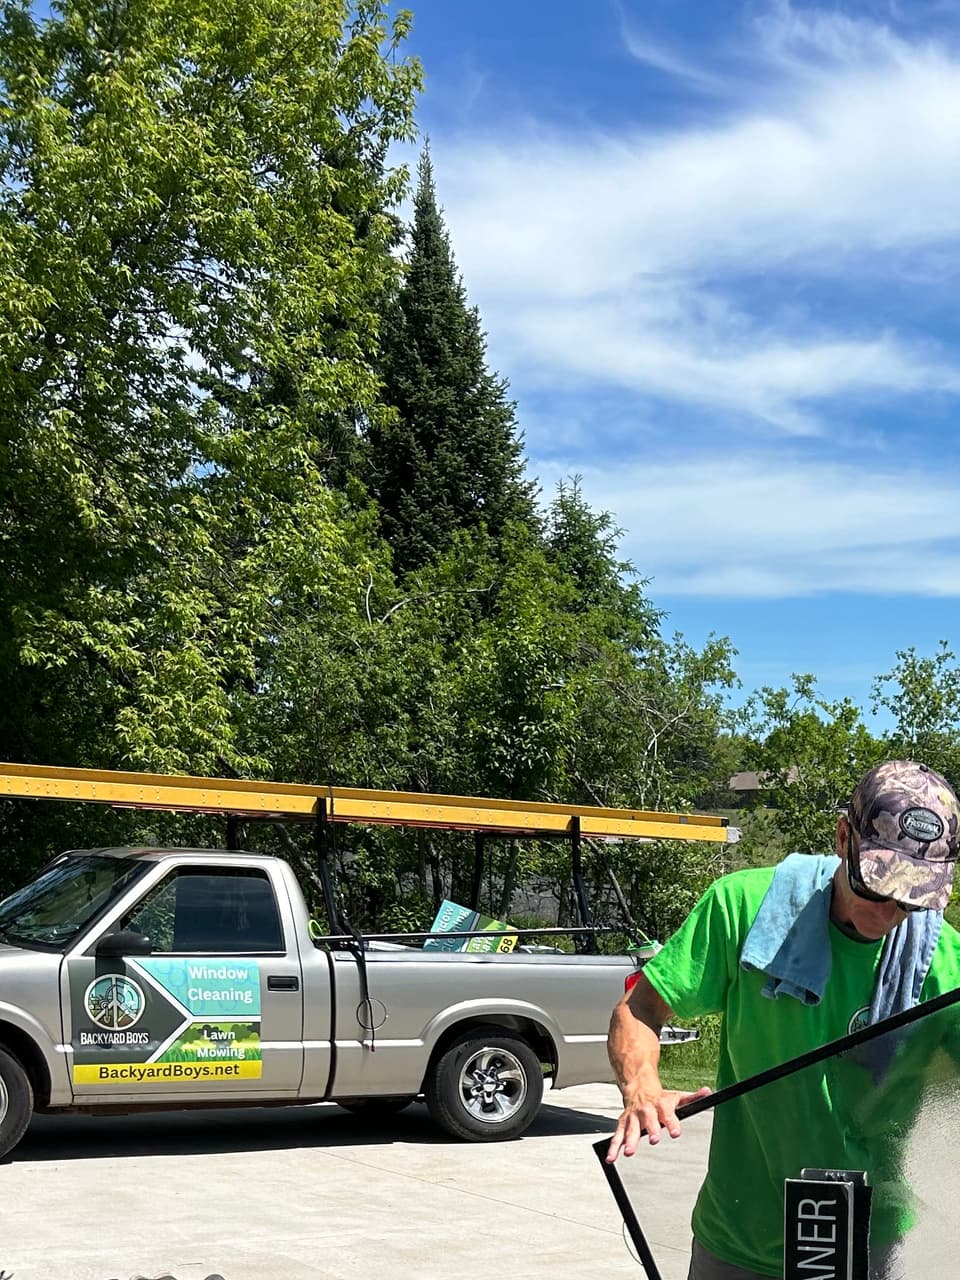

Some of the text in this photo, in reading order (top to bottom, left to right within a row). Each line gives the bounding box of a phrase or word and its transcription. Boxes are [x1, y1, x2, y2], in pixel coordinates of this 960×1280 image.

[188, 966, 248, 979] Window
[188, 988, 253, 1003] Cleaning
[80, 1031, 149, 1045] BACKYARD BOYS
[203, 1029, 236, 1040] Lawn
[197, 1047, 245, 1059] Mowing
[99, 1064, 240, 1081] BackyardBoys.net
